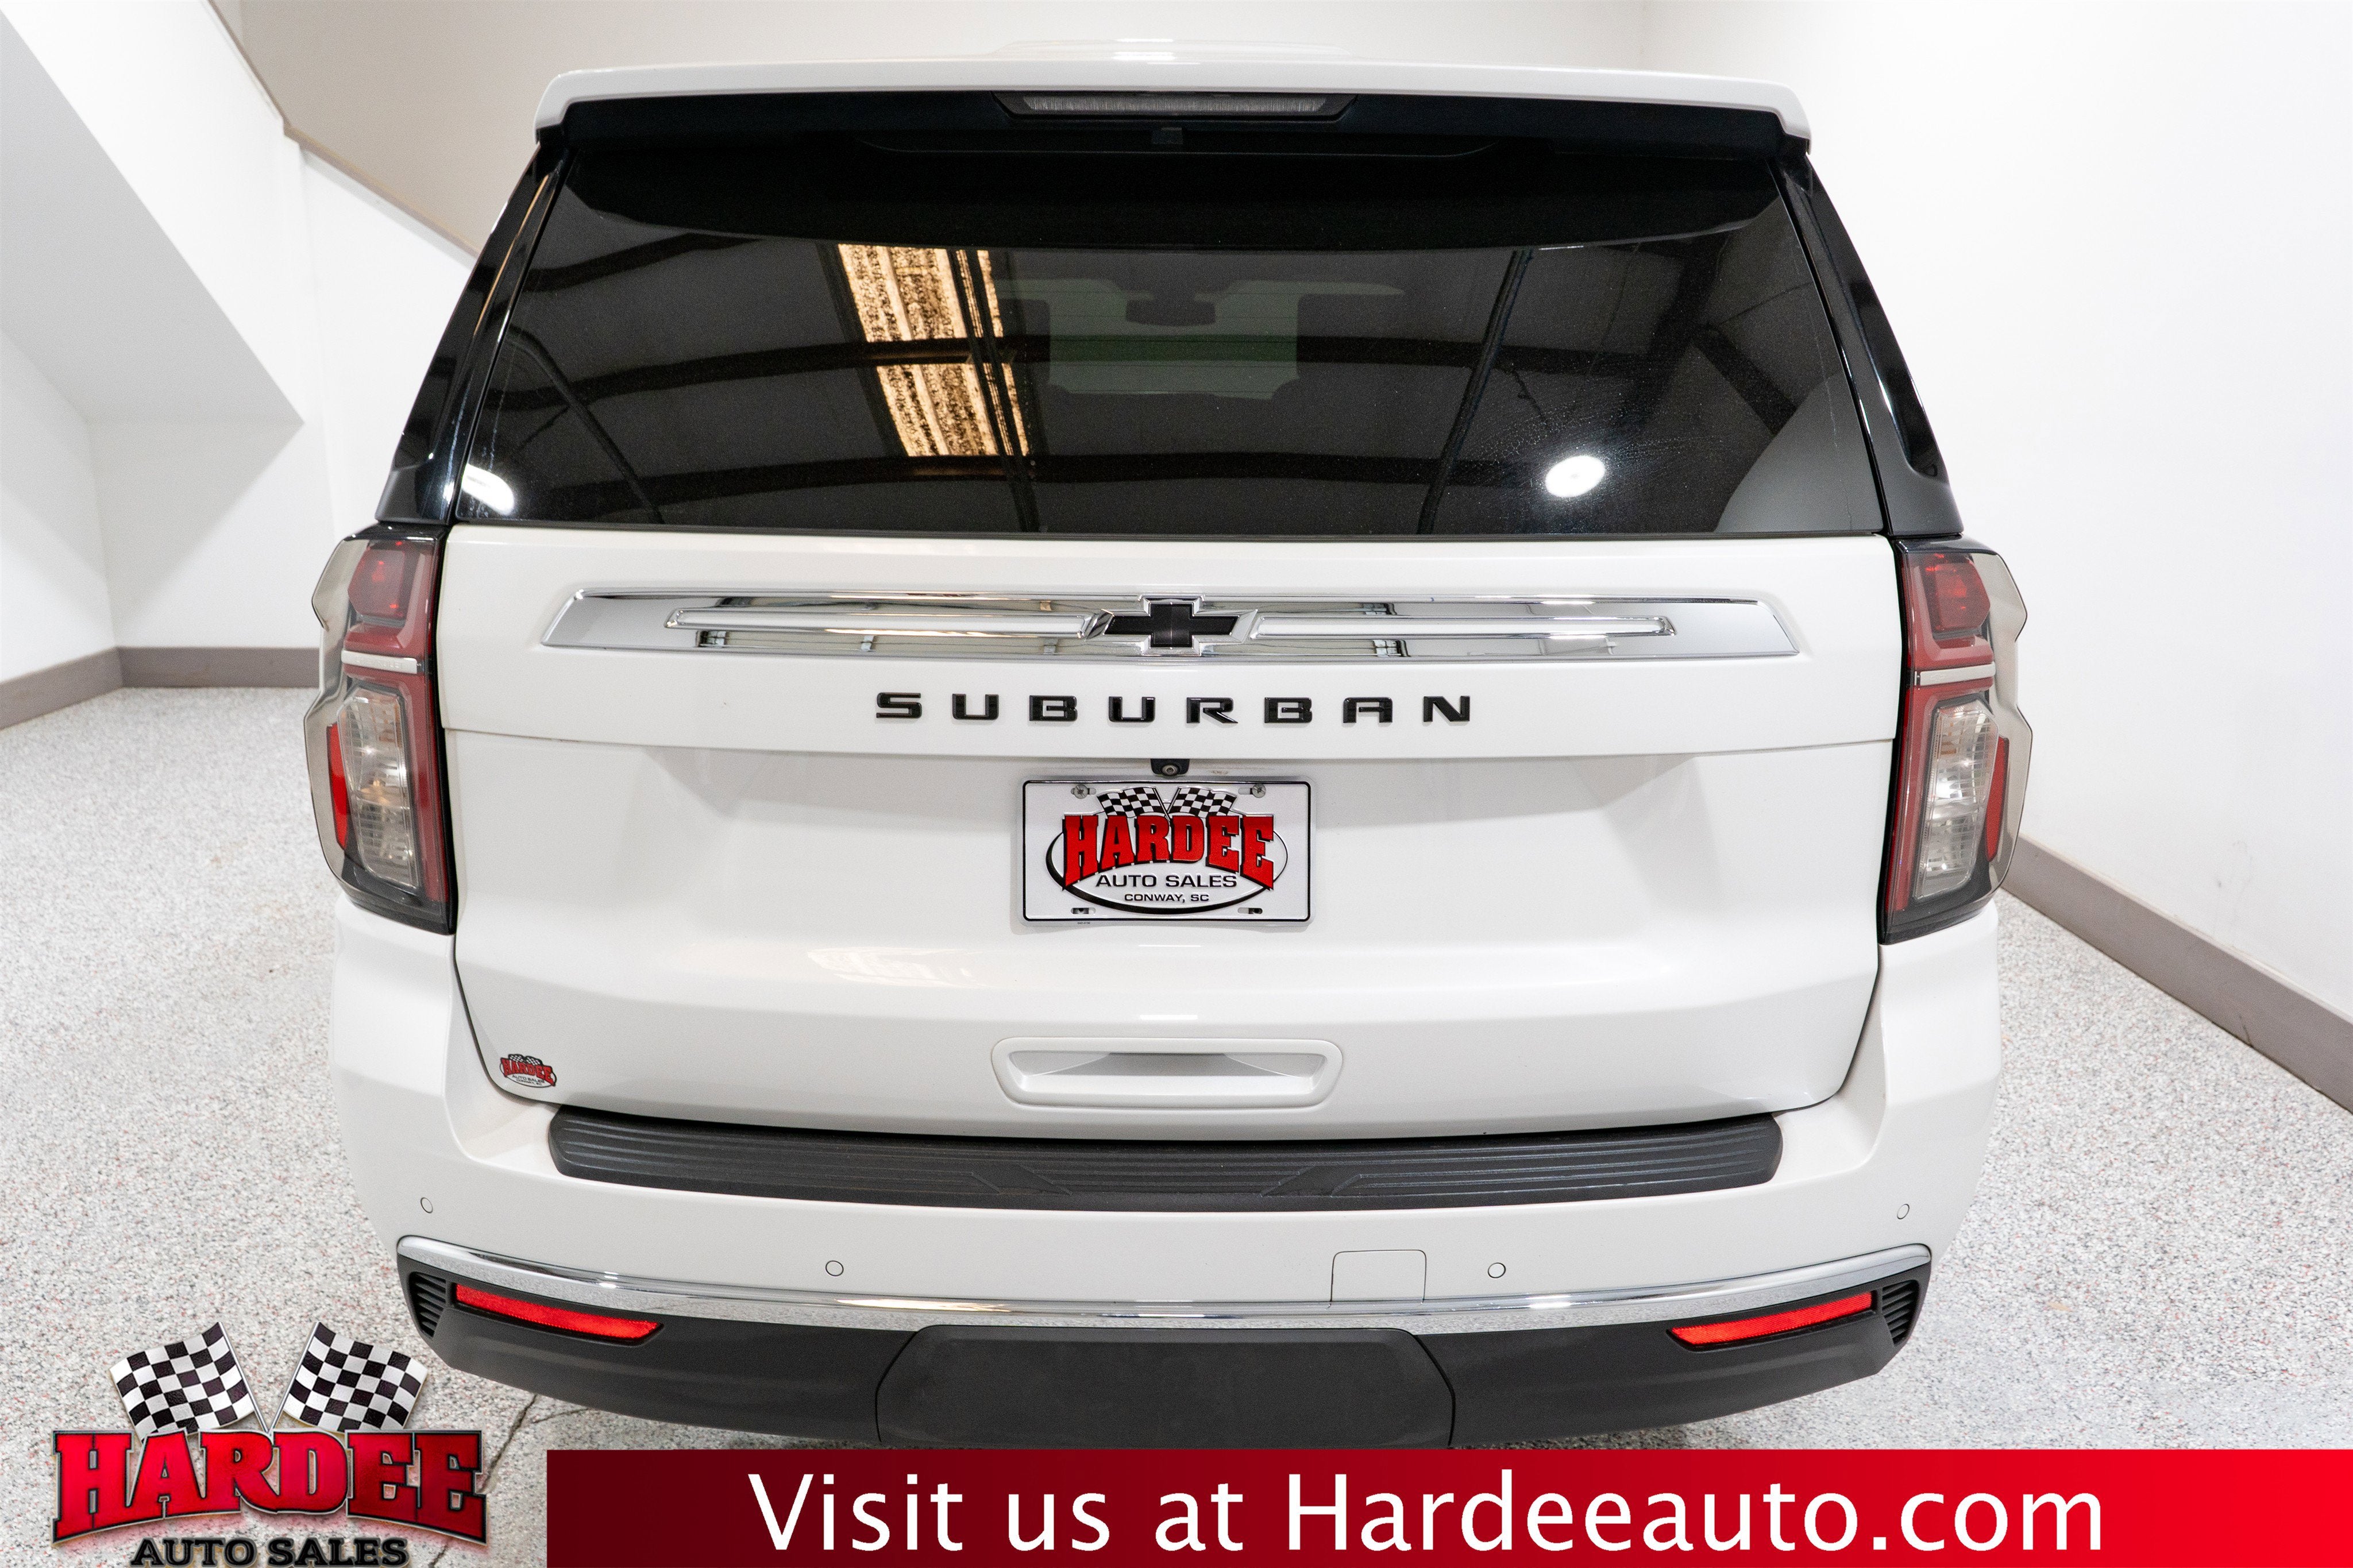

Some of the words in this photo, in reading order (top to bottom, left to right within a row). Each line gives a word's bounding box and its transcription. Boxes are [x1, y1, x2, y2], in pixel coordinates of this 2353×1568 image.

[875, 692, 1471, 724] SUBURBAN
[1063, 814, 1274, 890] HARDEE
[1096, 875, 1158, 887] AUTO
[1166, 875, 1237, 887] SALES
[1124, 894, 1185, 903] CONWAY,
[1190, 894, 1209, 902] SC
[500, 1057, 556, 1087] HARDEE
